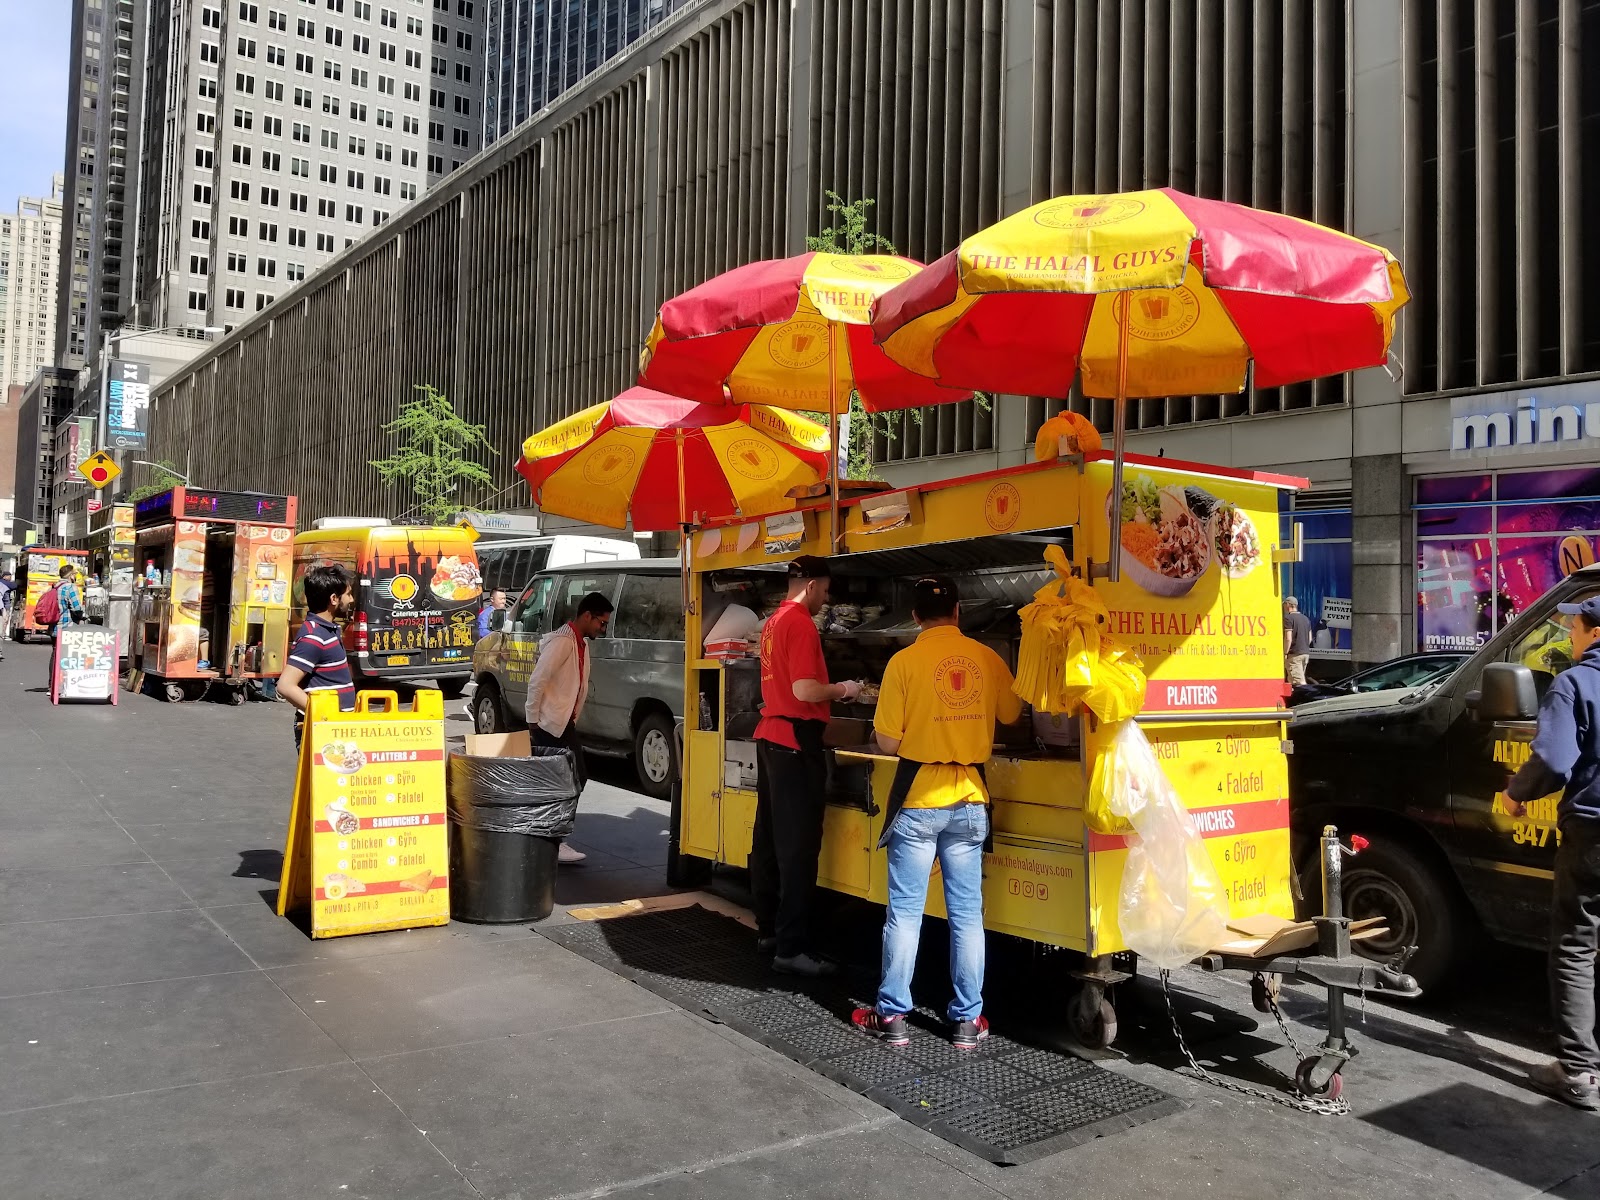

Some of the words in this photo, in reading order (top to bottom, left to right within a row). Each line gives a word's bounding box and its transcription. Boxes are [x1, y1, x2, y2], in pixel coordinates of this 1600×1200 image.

[969, 254, 1017, 270] THE
[1025, 255, 1106, 272] HALAL
[1113, 246, 1177, 270] GUYS
[813, 289, 849, 306] THE
[109, 380, 124, 402] MAY
[527, 438, 549, 451] THE
[551, 425, 583, 445] HALAL
[768, 415, 797, 437] HALAL
[799, 430, 825, 445] GUYS
[391, 610, 419, 618] Catering
[1106, 611, 1145, 635] THE
[1150, 612, 1216, 636] HALAL
[1221, 614, 1267, 637] GUYS
[61, 631, 116, 645] BREAK
[1139, 643, 1147, 655] 10
[1148, 647, 1161, 655] a.m.
[1168, 643, 1172, 655] 4
[1220, 644, 1227, 656] 10
[60, 656, 112, 670] CREPES
[936, 668, 944, 682] THE
[942, 658, 966, 669] HALAL
[967, 662, 981, 680] GUYS
[1167, 685, 1218, 706] PLATTERS
[331, 728, 358, 739] THE
[360, 727, 400, 738] HALAL
[402, 726, 432, 737] GUYS
[371, 751, 408, 762] PLATTERS
[1151, 736, 1180, 759] cken
[1216, 741, 1222, 753] 2
[1225, 734, 1250, 758] Gyro
[1492, 740, 1533, 764] ALTA
[350, 774, 382, 787] Chicken
[397, 773, 416, 786] Gyro
[1217, 782, 1223, 793] 4
[1226, 770, 1264, 795] Falafel
[350, 795, 377, 807] Combo
[397, 791, 424, 804] Falafel
[372, 815, 420, 828] SANDWICHES
[1190, 809, 1235, 833] WICHES
[351, 837, 383, 850] Chicken
[398, 835, 417, 848] Gyro
[1512, 821, 1550, 848] 347
[351, 858, 378, 870] Combo
[398, 853, 426, 867] Falafel
[1225, 850, 1230, 862] 6
[1233, 841, 1256, 865] Gyro
[1233, 874, 1267, 902] Falafel
[324, 903, 351, 915] HUMMUS
